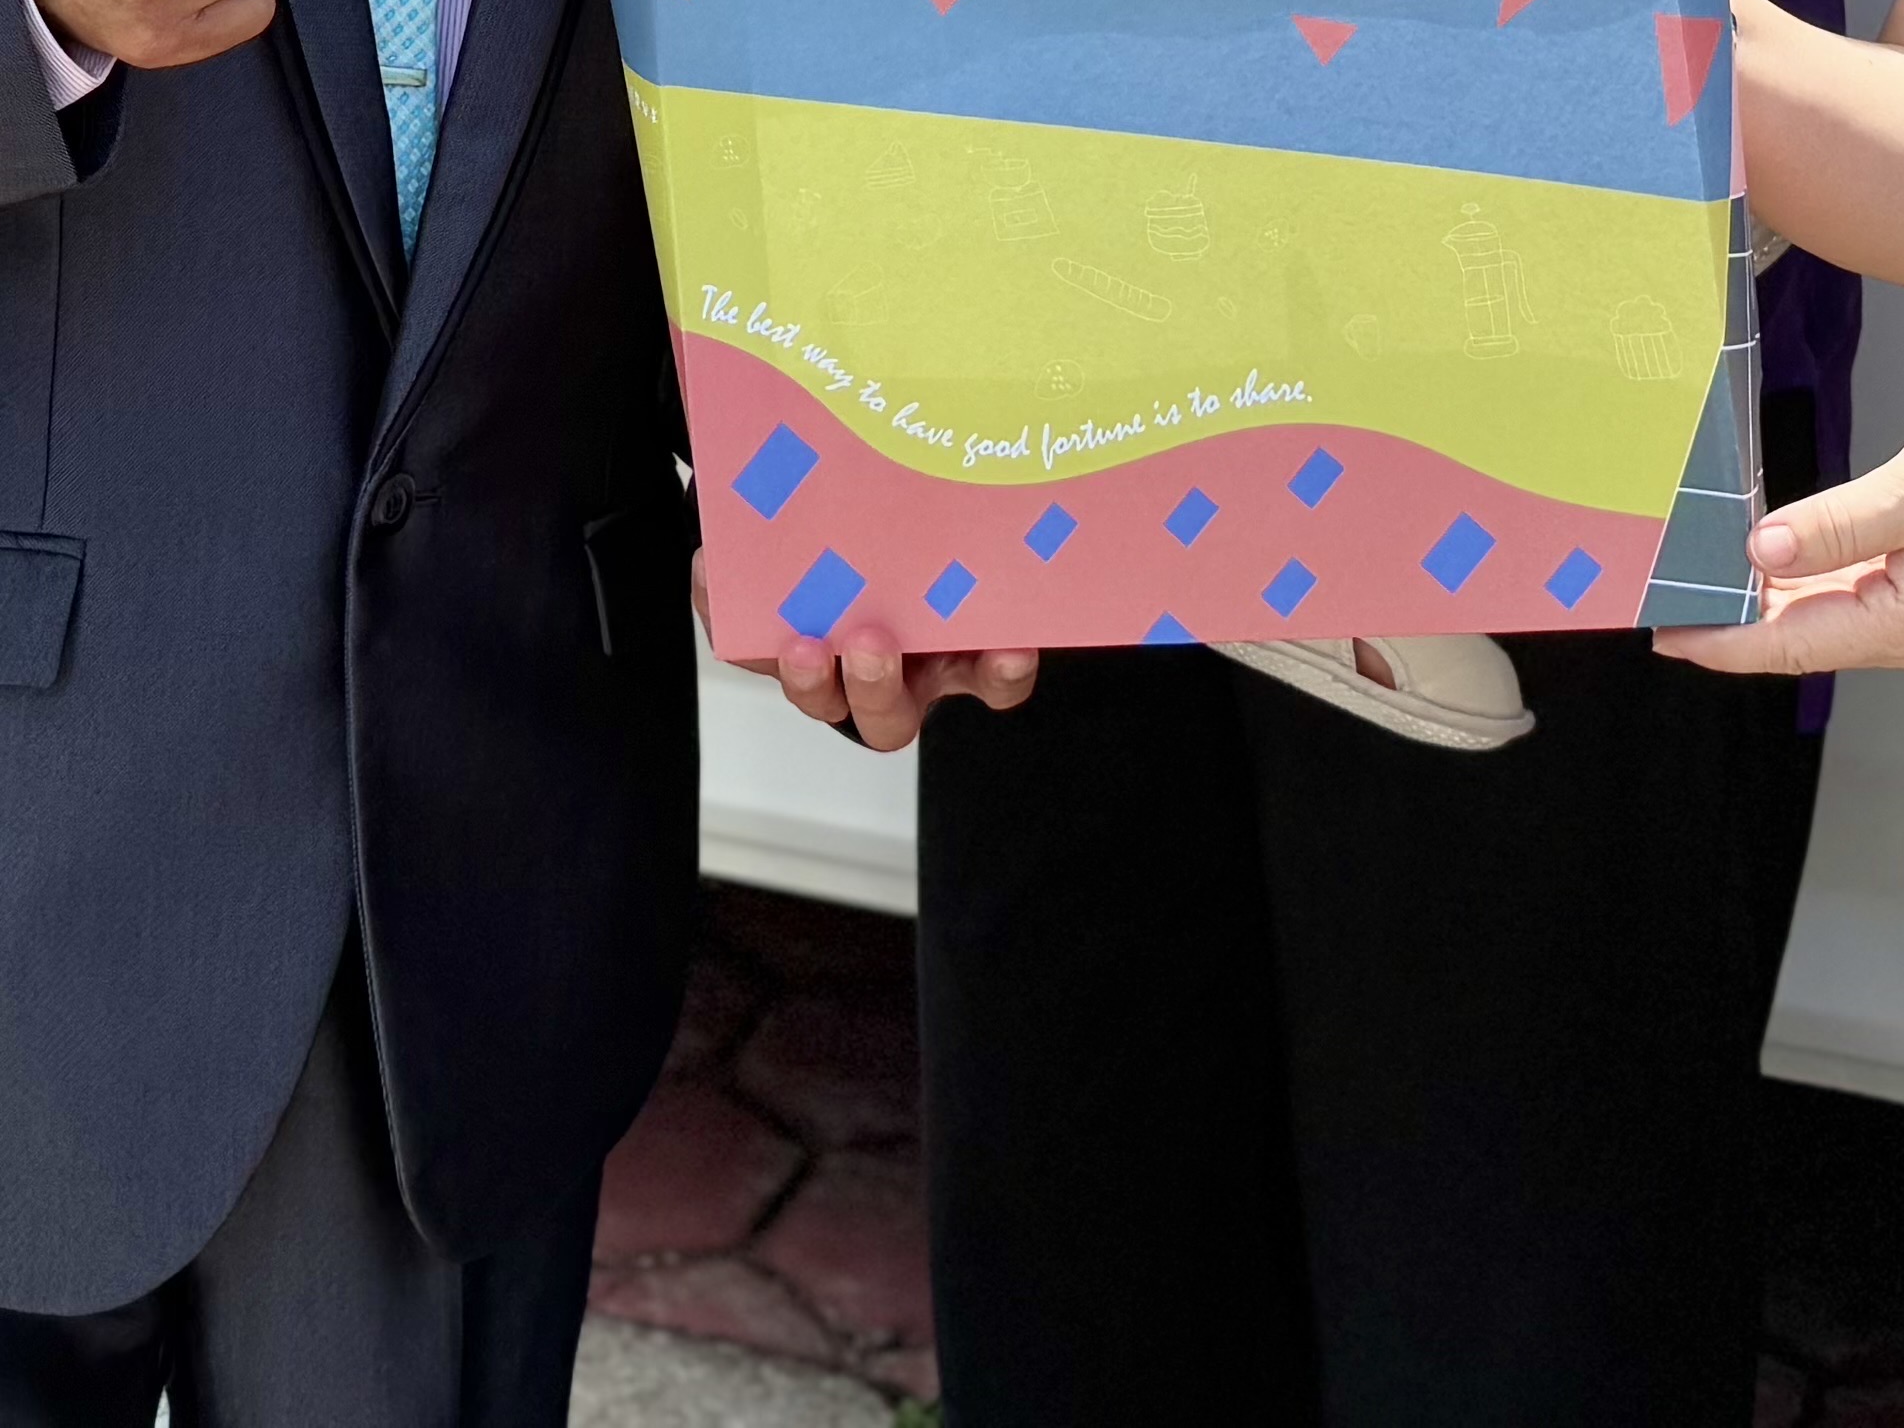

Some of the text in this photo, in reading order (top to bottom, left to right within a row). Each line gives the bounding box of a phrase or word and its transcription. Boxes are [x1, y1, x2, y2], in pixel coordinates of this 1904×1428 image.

[701, 284, 1313, 471] The best way to have good fortune is to share.
